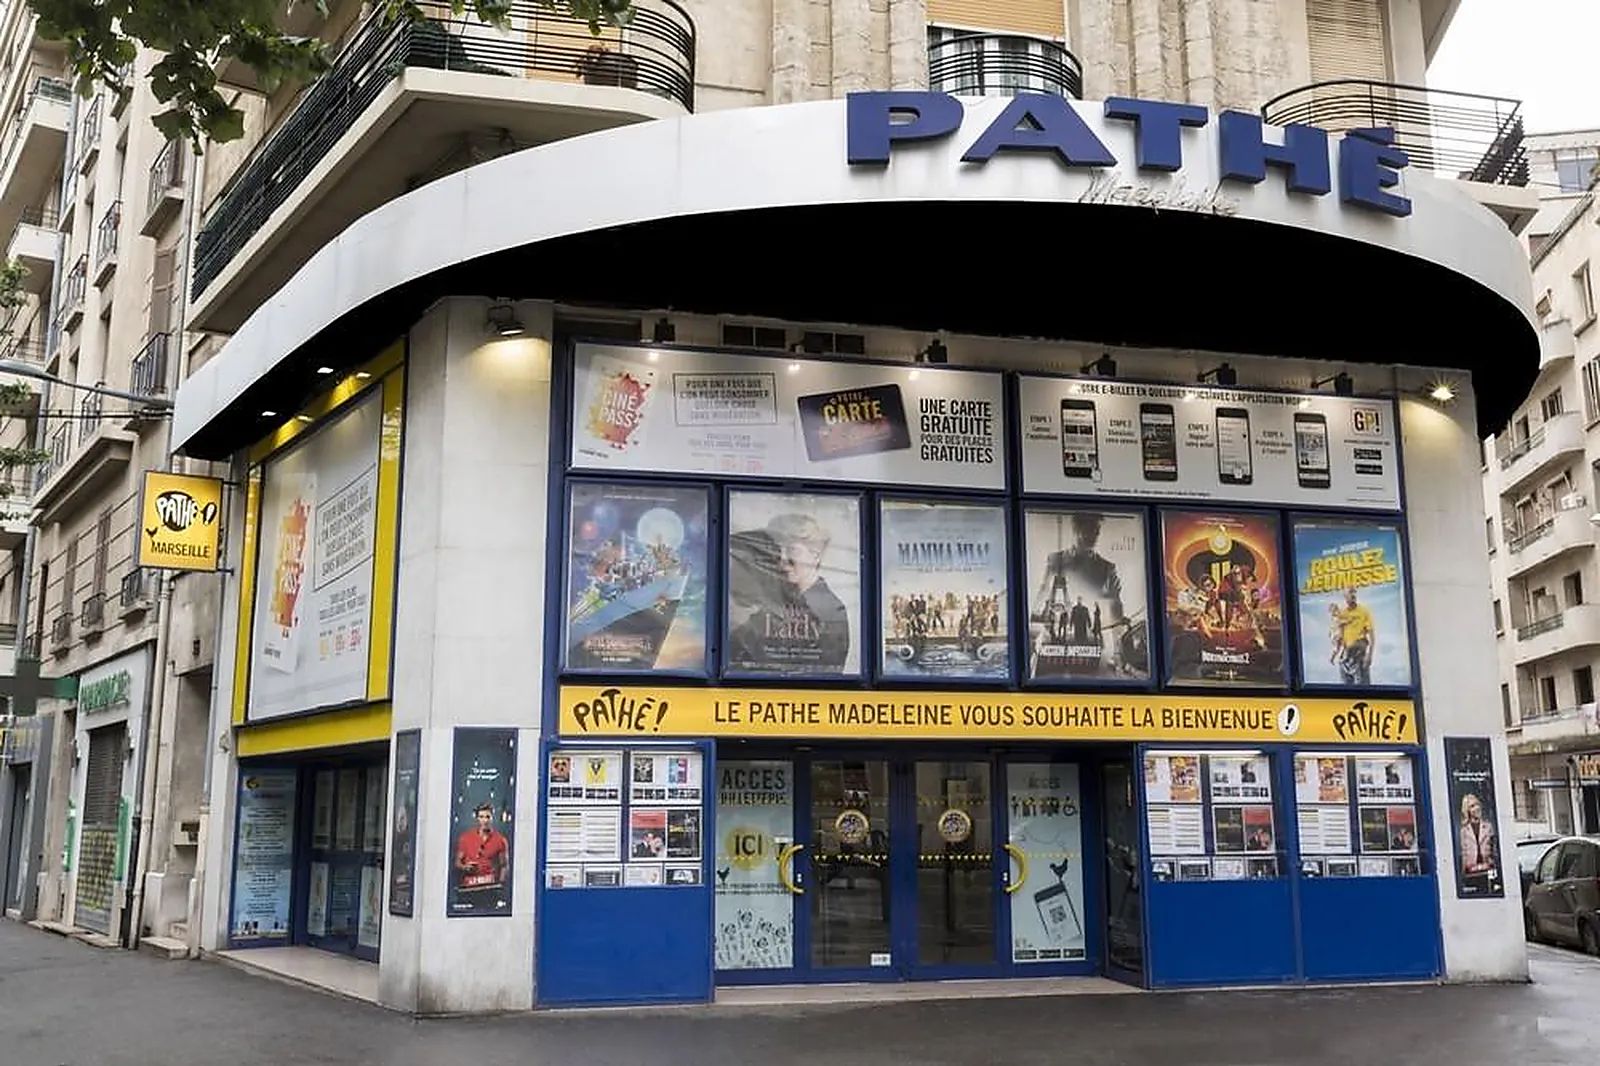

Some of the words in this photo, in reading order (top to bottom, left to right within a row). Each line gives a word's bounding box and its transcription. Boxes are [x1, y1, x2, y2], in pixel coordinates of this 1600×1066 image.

[823, 400, 883, 425] CARTE
[920, 398, 946, 415] UNE
[950, 399, 992, 418] CARTE
[920, 415, 992, 436] GRATUITE
[1354, 411, 1380, 433] GP!
[921, 433, 943, 444] POUR
[920, 444, 994, 464] GRATUITES
[151, 541, 211, 559] MARSEILLE
[1309, 547, 1384, 578] ROULEZ
[1301, 564, 1397, 595] JEUNESSE
[715, 701, 740, 722] LE
[749, 701, 820, 724] PATHE
[829, 702, 952, 726] MADELEINE
[960, 704, 1014, 727] VOUS
[1023, 705, 1124, 727] SOUHAITE
[1131, 707, 1155, 728] LA
[1162, 708, 1273, 730] BIENVENUE
[721, 769, 785, 790] ACCES
[734, 834, 763, 857] ICI
